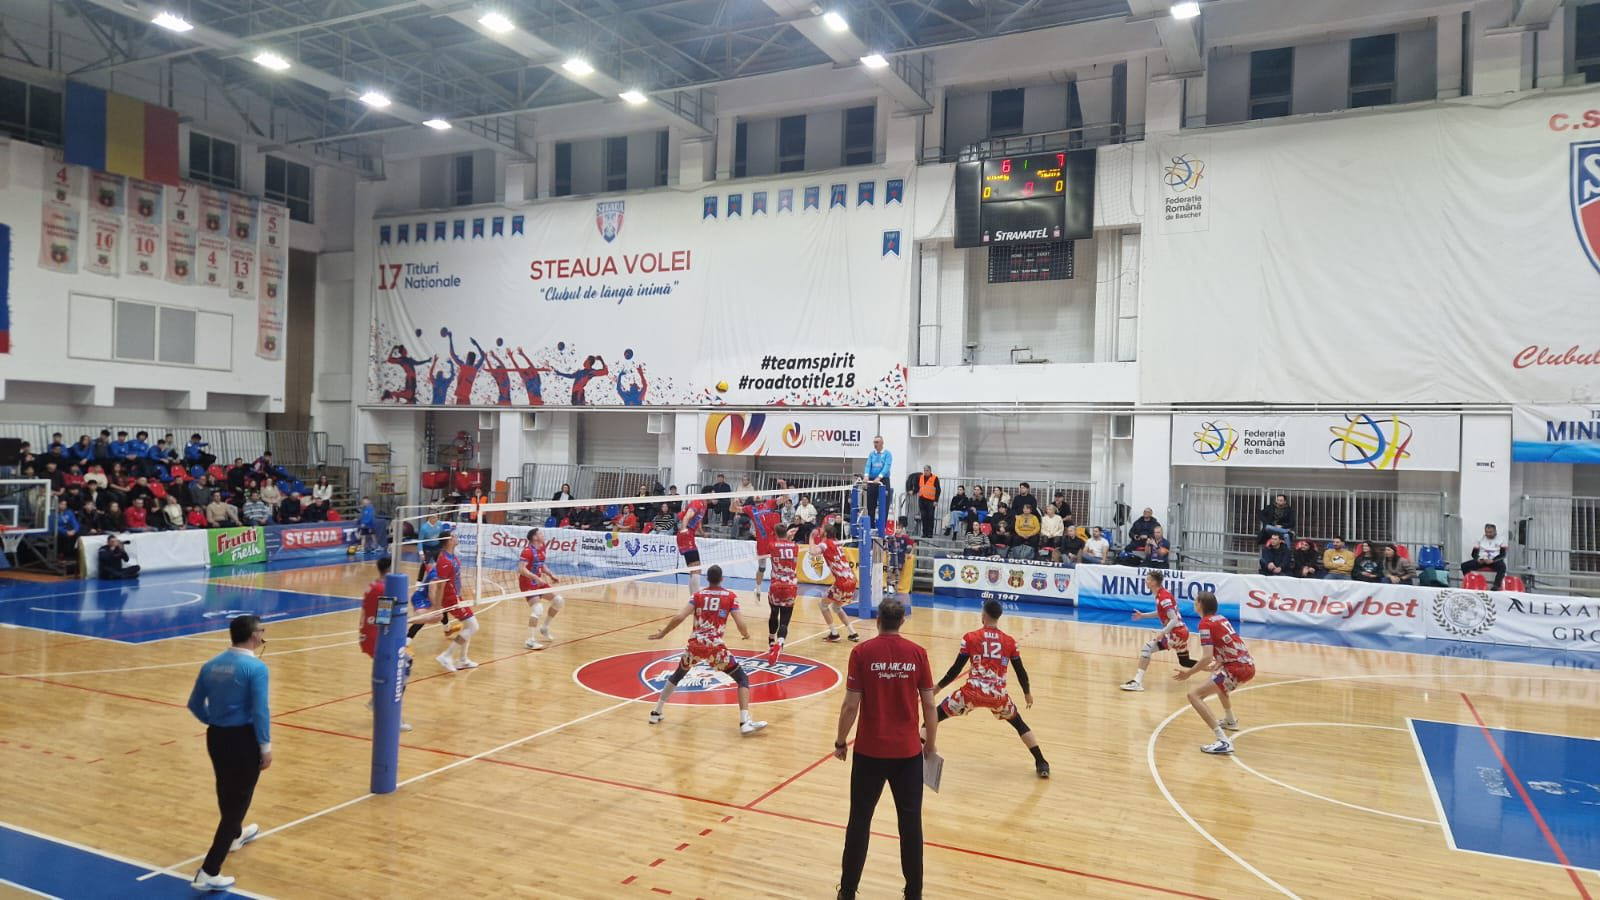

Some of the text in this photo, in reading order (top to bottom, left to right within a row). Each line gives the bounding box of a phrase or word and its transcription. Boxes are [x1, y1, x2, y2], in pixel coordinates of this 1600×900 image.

[1002, 158, 1011, 174] 6
[1055, 153, 1065, 168] 7
[57, 167, 67, 183] 4
[983, 186, 991, 199] 0
[1055, 180, 1064, 192] 0
[178, 187, 187, 202] 7
[268, 216, 277, 232] 5
[994, 227, 1049, 242] STRAMATEL
[207, 251, 217, 266] 4
[530, 250, 691, 280] STEAUA VOLEI
[233, 261, 249, 276] 13
[378, 261, 440, 290] 17 Titluri
[583, 285, 598, 300] de
[760, 352, 856, 373] #teamspirit
[738, 372, 856, 390] #roadtotitle18
[810, 429, 862, 442] FRVOLEI
[1244, 437, 1286, 447] Română
[1243, 447, 1254, 455] de
[217, 527, 258, 556] Frutti
[285, 529, 338, 546] STEAUA
[231, 546, 261, 562] Fresh
[643, 544, 677, 554] SAFIR
[779, 548, 794, 559] 10
[703, 596, 720, 612] 18
[998, 593, 1020, 601] 1947
[1246, 589, 1419, 619] Stanleybet
[982, 641, 1002, 658] 12
